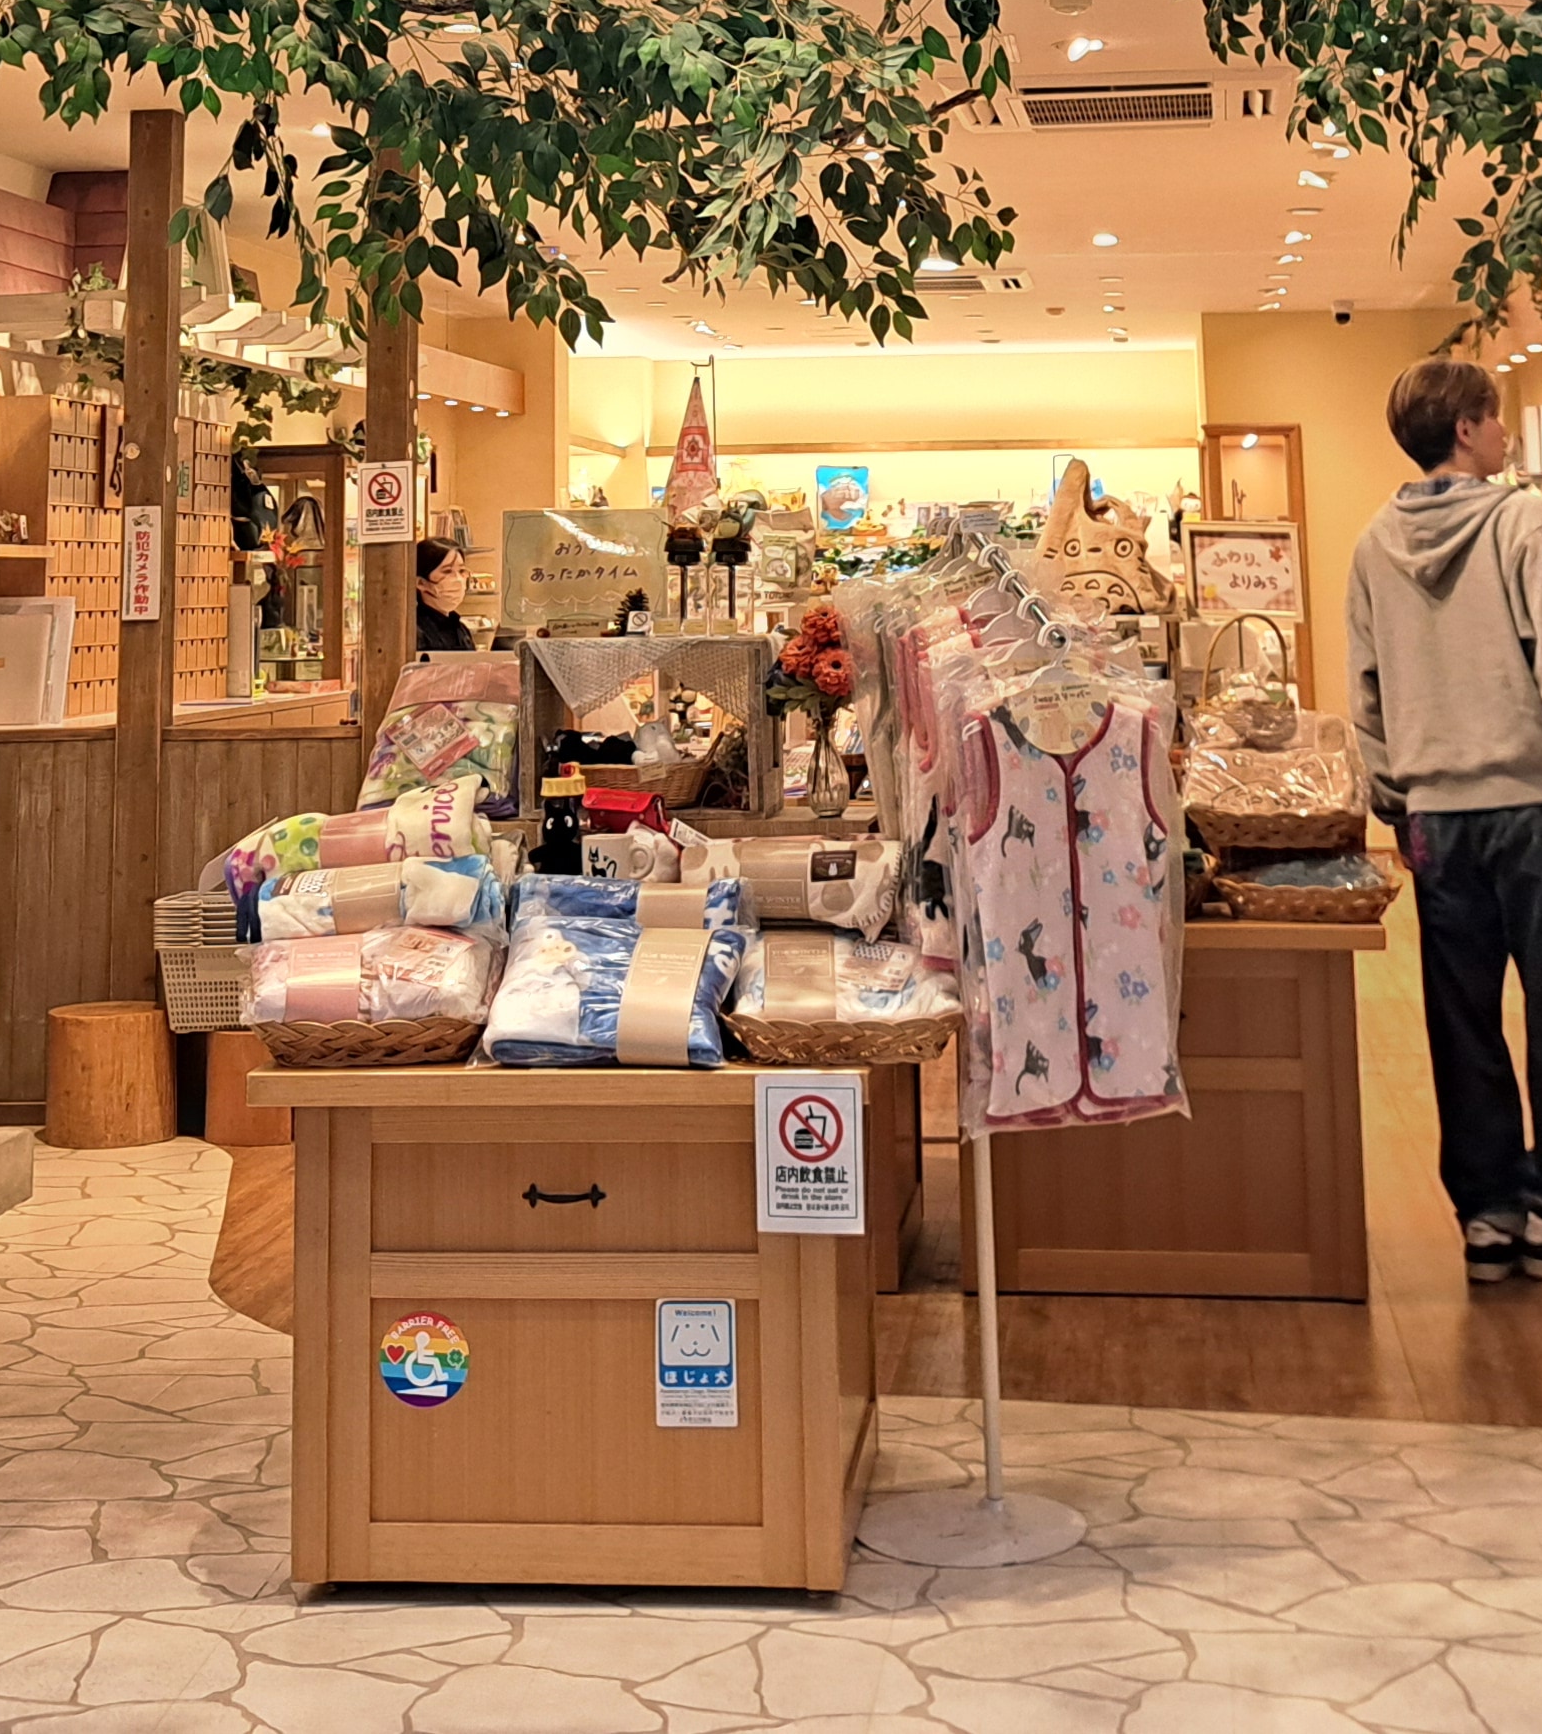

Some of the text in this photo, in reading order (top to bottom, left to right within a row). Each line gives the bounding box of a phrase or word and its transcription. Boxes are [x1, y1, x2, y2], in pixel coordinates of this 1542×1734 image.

[133, 530, 151, 615] 防犯カメラ作動中
[530, 566, 638, 583] あったかタイム
[1229, 572, 1278, 590] よりみち
[775, 1165, 849, 1184] 店内飲食禁止
[675, 1309, 717, 1317] Welcome!
[390, 1315, 460, 1344] BARRIER FREE
[664, 1369, 729, 1385] ほじょ犬
